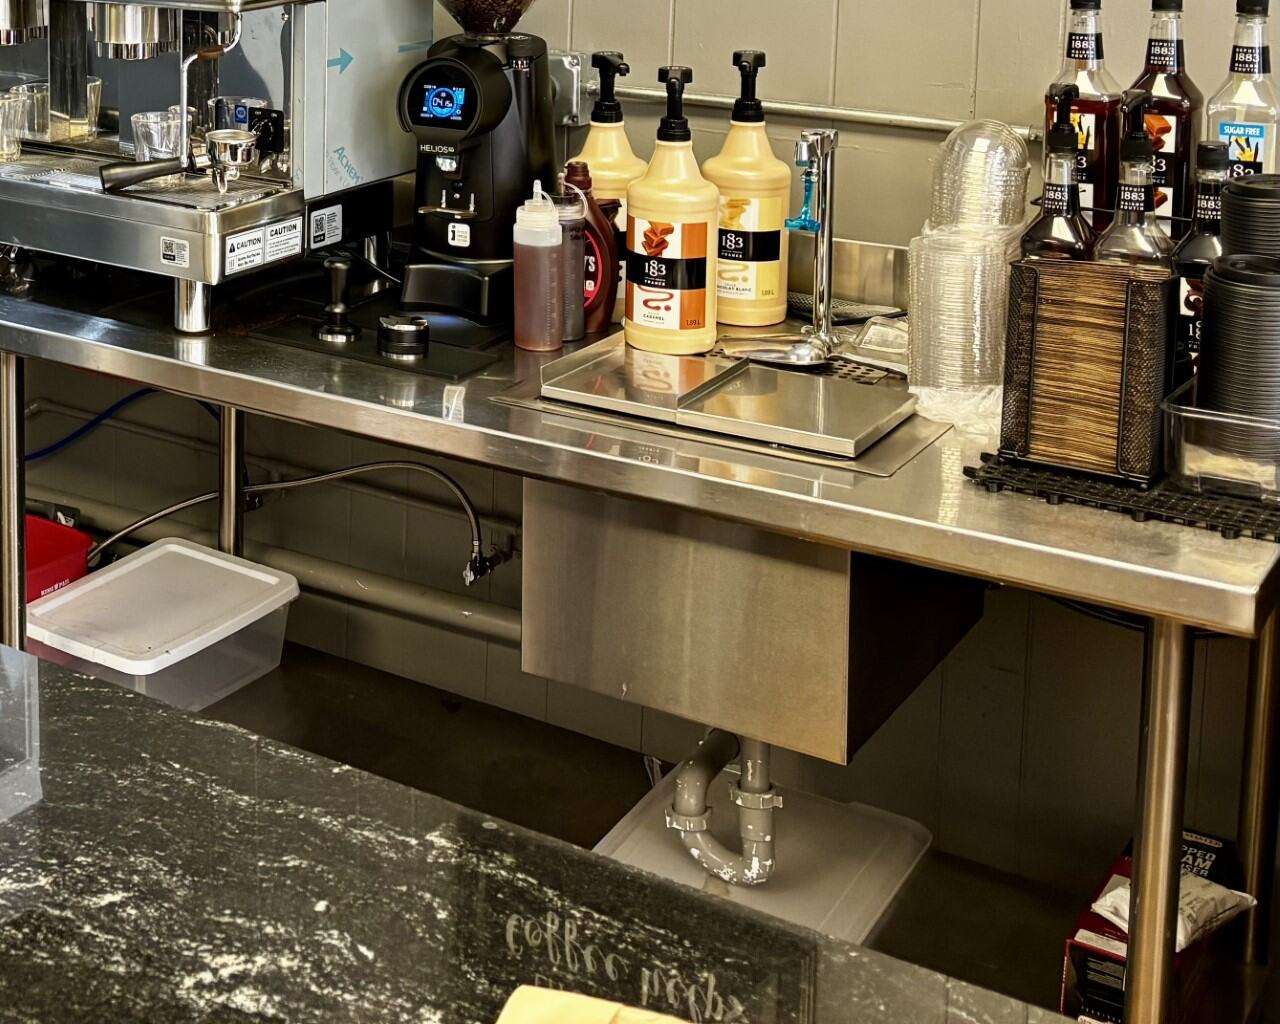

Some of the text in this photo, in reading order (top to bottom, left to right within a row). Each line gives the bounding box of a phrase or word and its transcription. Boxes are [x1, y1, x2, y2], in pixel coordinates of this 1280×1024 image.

[1071, 40, 1096, 49] 1883
[1151, 46, 1175, 56] 1883
[1235, 53, 1260, 62] 1883
[1224, 125, 1261, 136] SUGAR FREE
[420, 144, 448, 154] HELIOS
[1045, 190, 1069, 200] 1883
[1121, 191, 1145, 201] 1883
[1197, 200, 1221, 209] 1883
[270, 223, 297, 237] CAUTION
[236, 236, 261, 250] CAUTION
[644, 260, 667, 277] 1883
